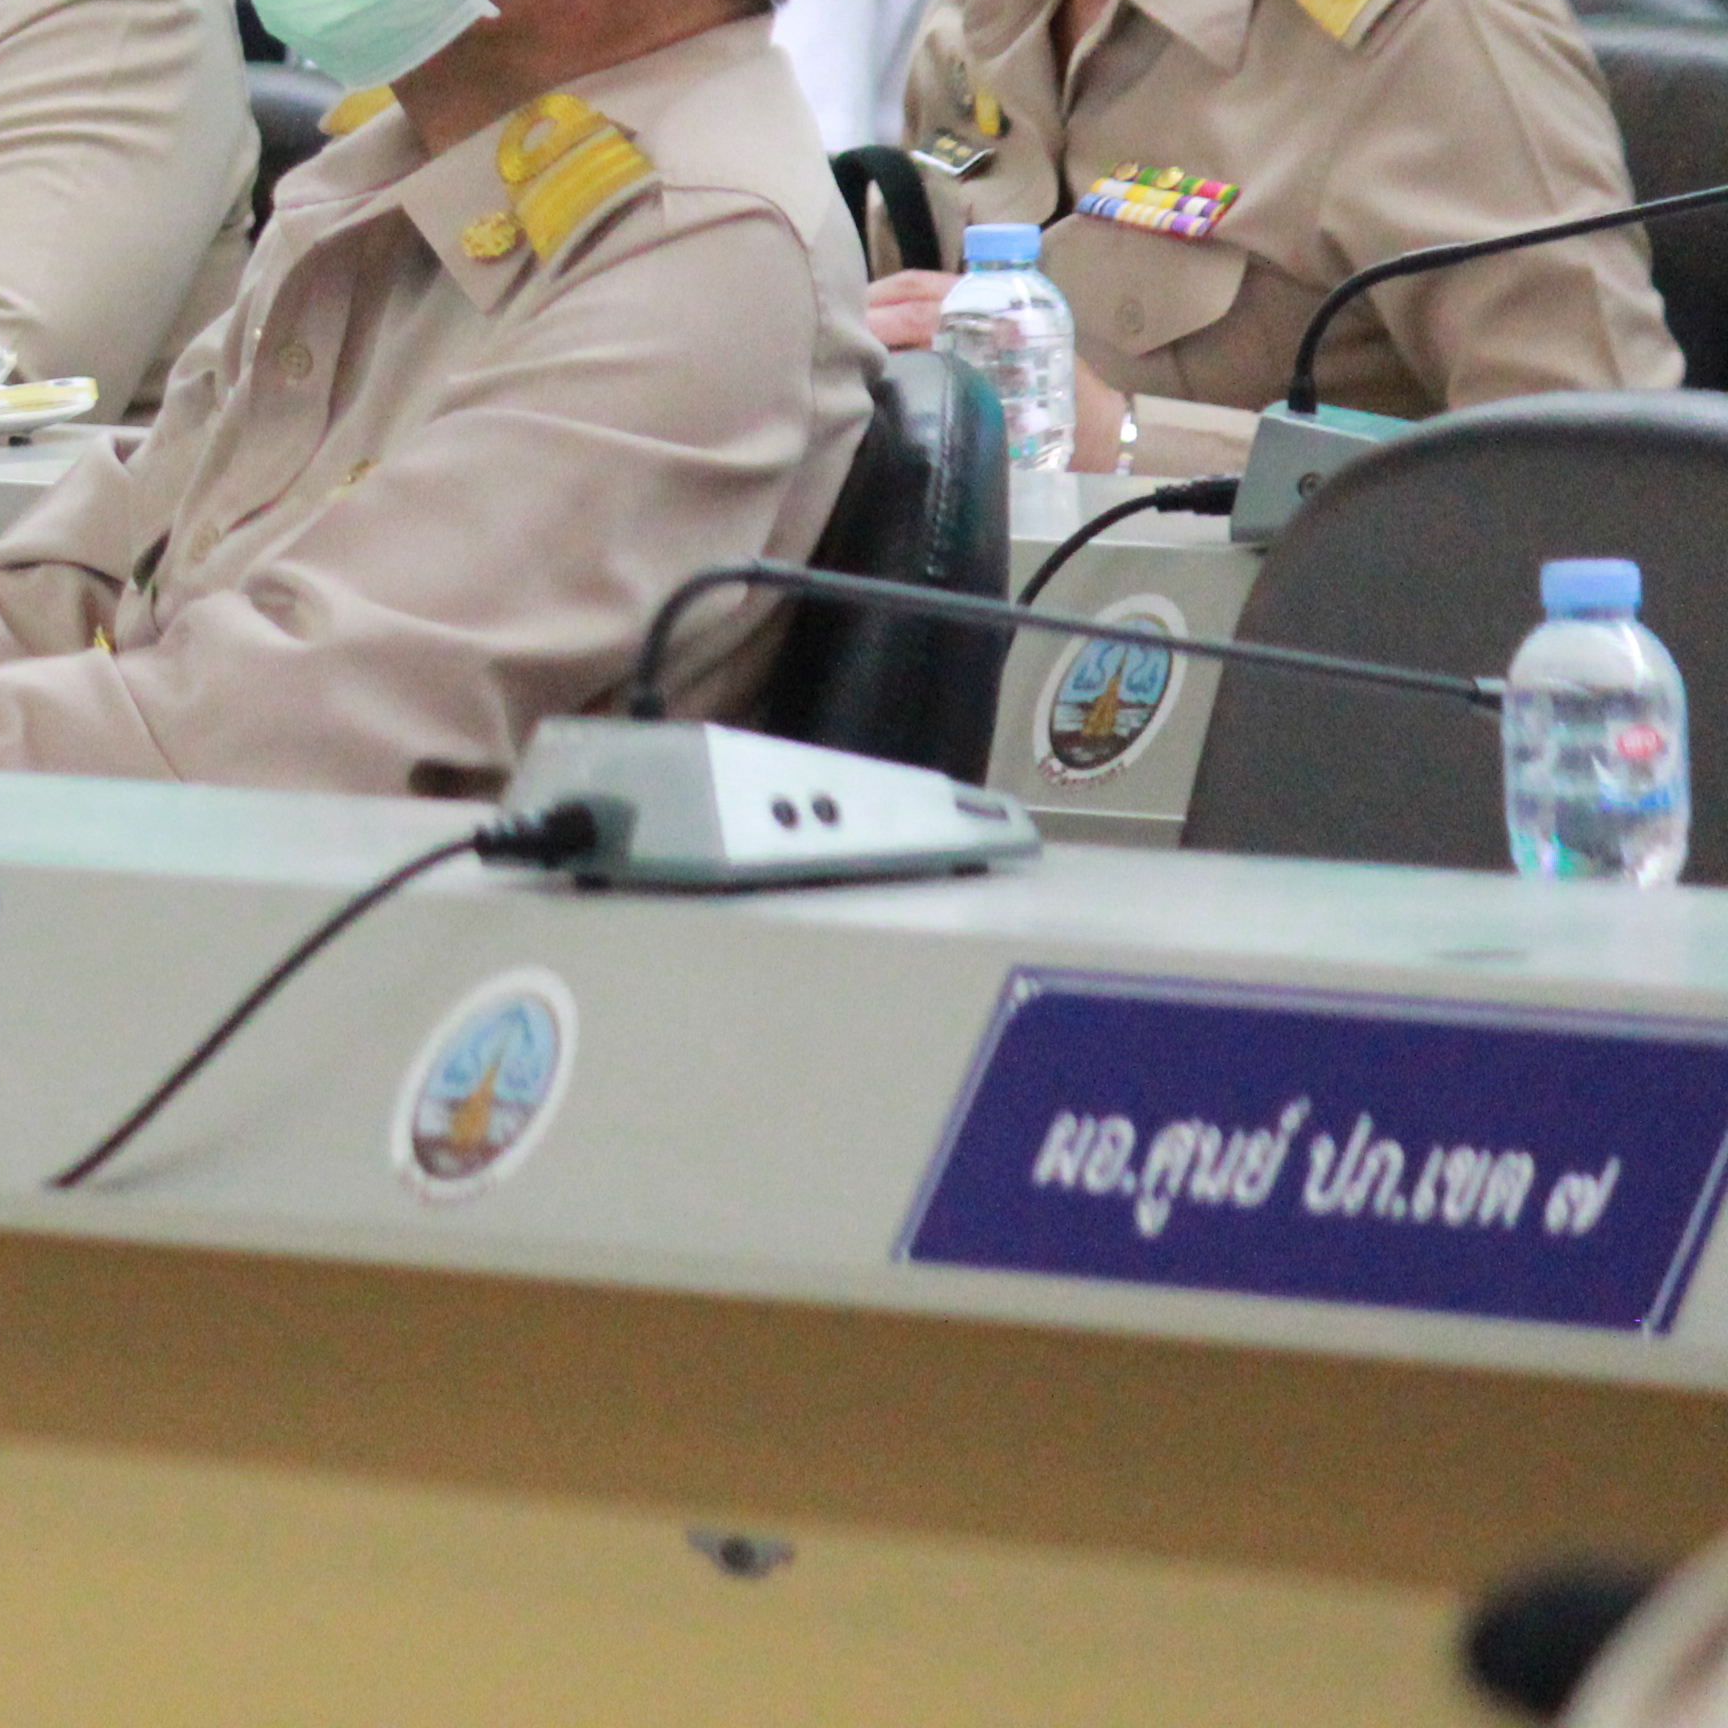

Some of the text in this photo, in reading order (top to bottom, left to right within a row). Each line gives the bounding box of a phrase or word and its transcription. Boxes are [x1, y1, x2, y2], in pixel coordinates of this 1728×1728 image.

[1032, 1094, 1311, 1239] ผอ.ศูนย์
[1545, 1155, 1621, 1235] ๗
